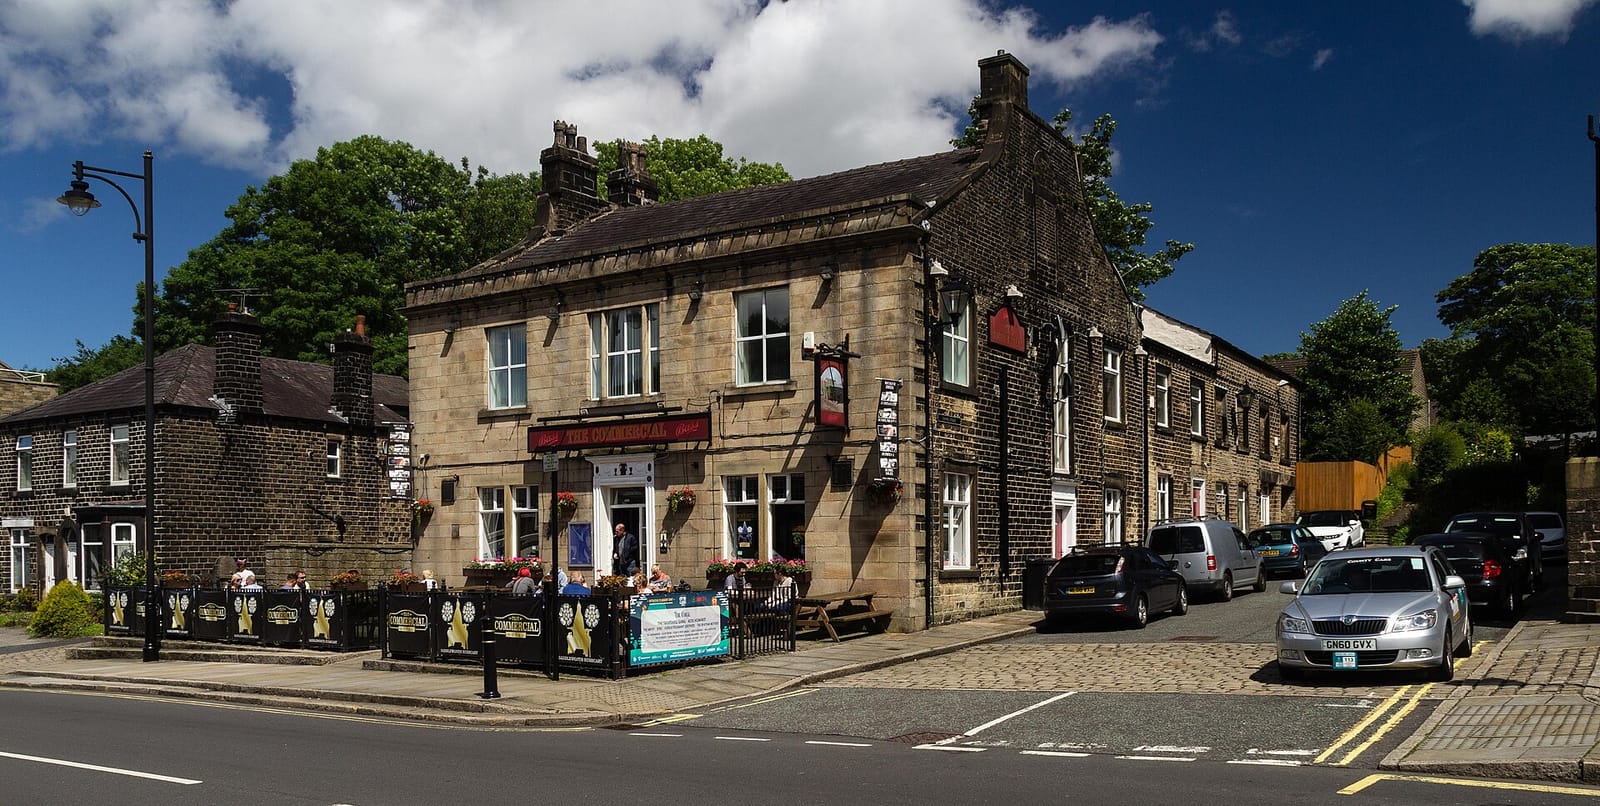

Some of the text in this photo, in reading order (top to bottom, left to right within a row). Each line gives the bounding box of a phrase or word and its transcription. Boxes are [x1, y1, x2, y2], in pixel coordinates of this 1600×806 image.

[566, 423, 666, 444] THE COMMERCIAL
[675, 421, 699, 435] Bass
[538, 432, 559, 444] Bass
[390, 615, 426, 627] COMMERCIAL
[494, 620, 539, 632] COMMERCIAL
[1326, 640, 1372, 649] GN60 GVX
